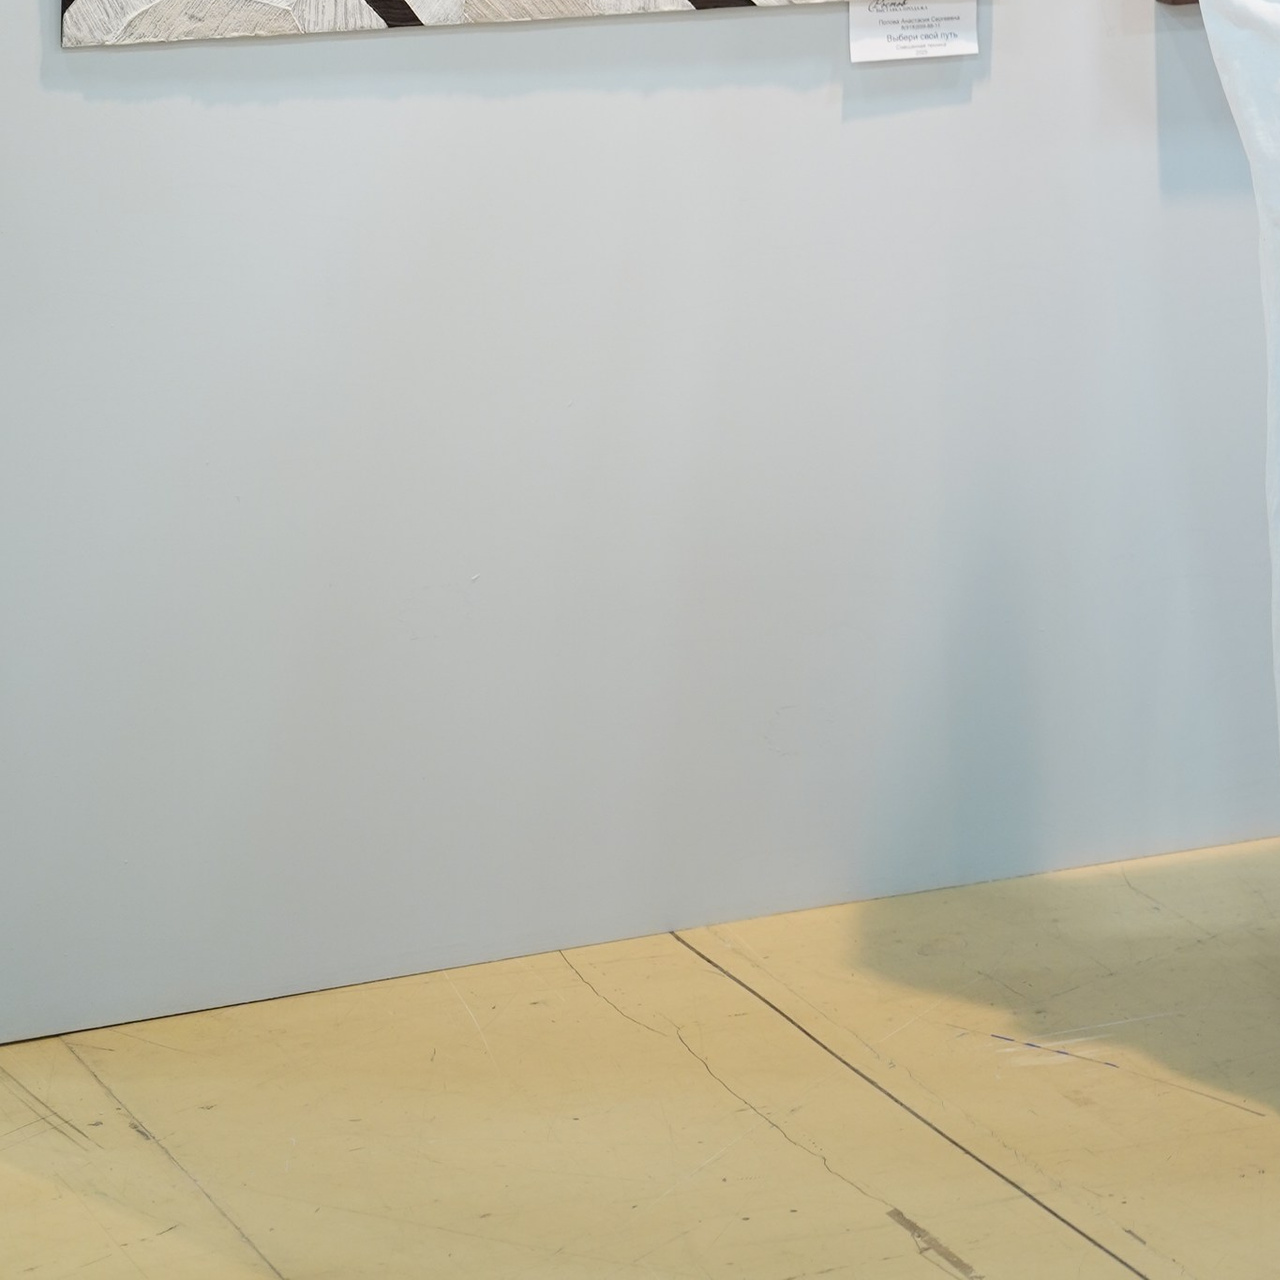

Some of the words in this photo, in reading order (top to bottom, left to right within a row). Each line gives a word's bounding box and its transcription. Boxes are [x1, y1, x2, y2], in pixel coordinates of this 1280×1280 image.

[886, 33, 918, 43] Выбери
[919, 31, 938, 40] свой
[940, 31, 958, 41] путь
